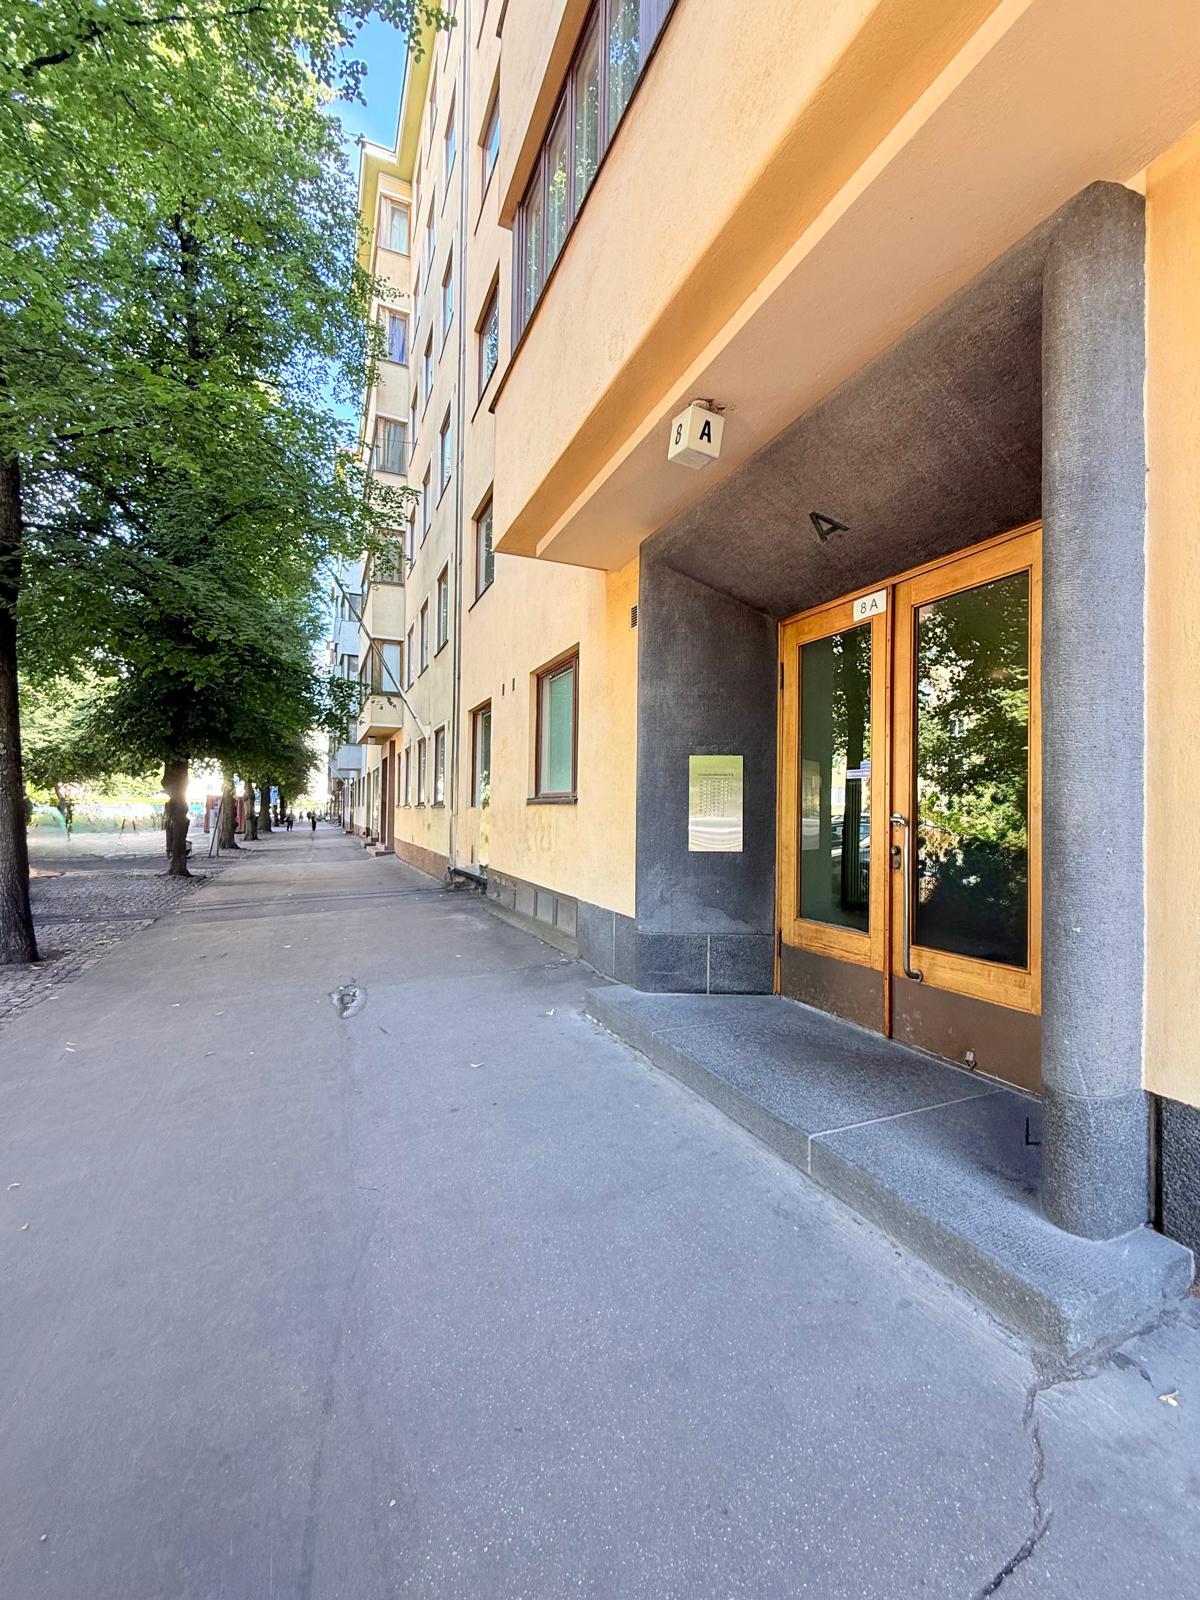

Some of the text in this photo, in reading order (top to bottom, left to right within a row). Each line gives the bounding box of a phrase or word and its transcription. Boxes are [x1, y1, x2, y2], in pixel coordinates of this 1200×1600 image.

[675, 423, 682, 445] 8
[699, 419, 711, 443] A
[809, 512, 849, 543] A
